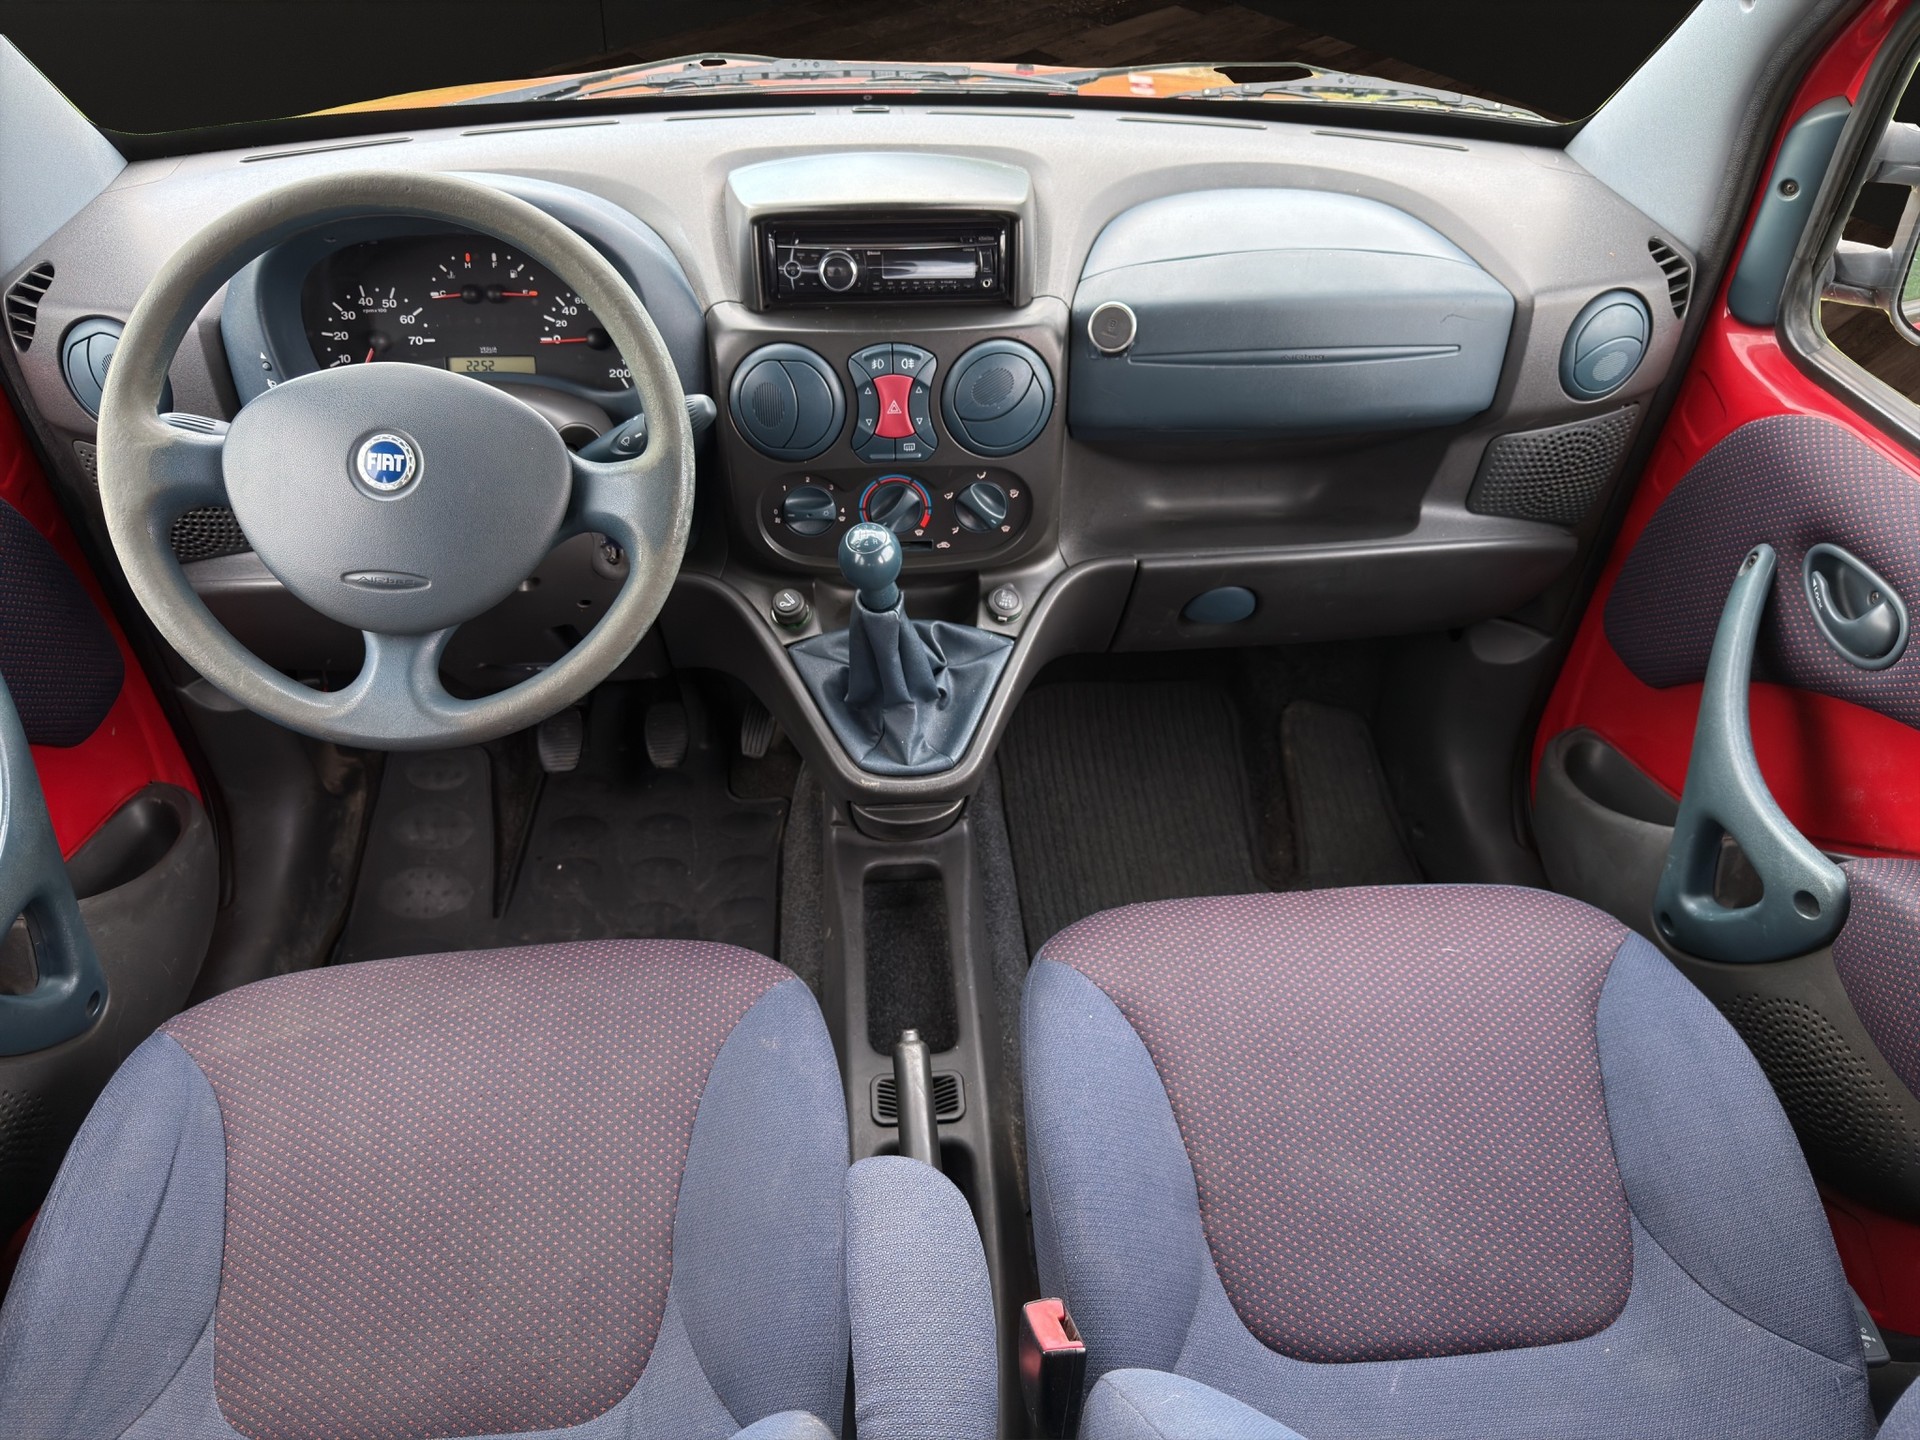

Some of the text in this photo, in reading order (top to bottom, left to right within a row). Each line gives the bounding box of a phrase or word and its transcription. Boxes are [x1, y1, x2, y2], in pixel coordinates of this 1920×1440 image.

[491, 261, 497, 269] F
[358, 297, 374, 306] 40
[382, 299, 397, 308] 50
[562, 306, 578, 316] 40
[340, 311, 356, 321] 30
[399, 315, 415, 324] 60
[333, 331, 349, 341] 20
[408, 336, 424, 345] 70
[553, 335, 561, 344] 0
[338, 354, 351, 363] 10
[466, 360, 495, 372] 2252
[609, 368, 631, 378] 200
[367, 454, 404, 472] FIAT
[1813, 587, 1823, 610] LOCK
